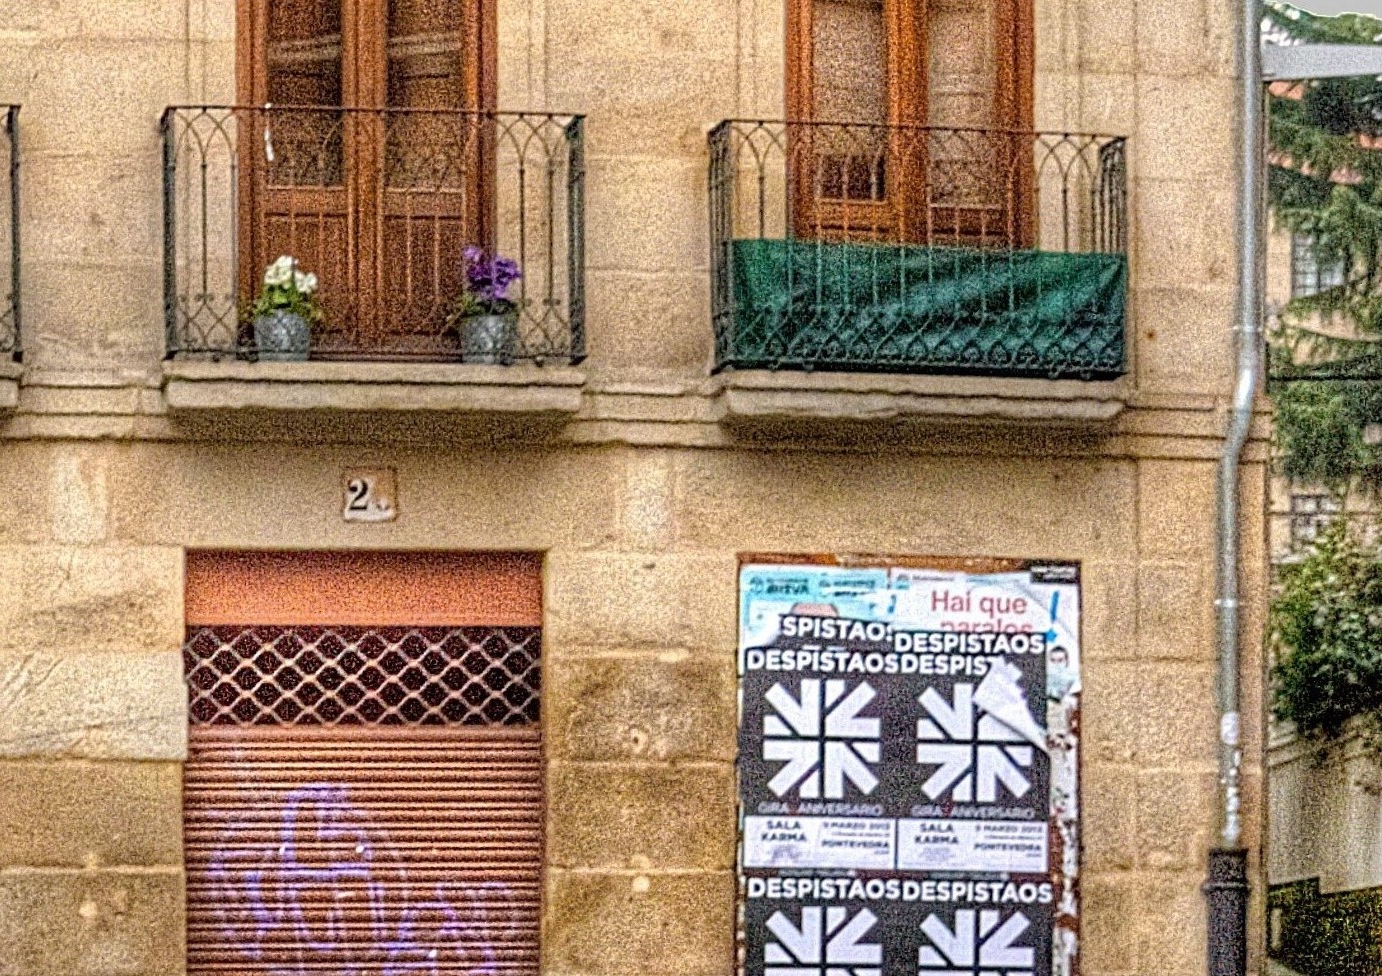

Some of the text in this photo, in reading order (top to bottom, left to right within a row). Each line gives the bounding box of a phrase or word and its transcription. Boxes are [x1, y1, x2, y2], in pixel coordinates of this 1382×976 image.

[931, 590, 1028, 619] Hai que
[894, 632, 1045, 655] DESPISTAOS
[746, 649, 899, 674] DESPISTAOS
[767, 820, 801, 830] SALA
[920, 823, 954, 833] SALA
[761, 832, 807, 842] KARMA
[915, 835, 959, 844] KARMA
[821, 839, 890, 848] PONTEVEDRA
[974, 843, 1042, 851] PONTEVEDRA
[747, 877, 900, 900] DESPISTAOS
[902, 880, 1053, 902] DESPISTAOS
